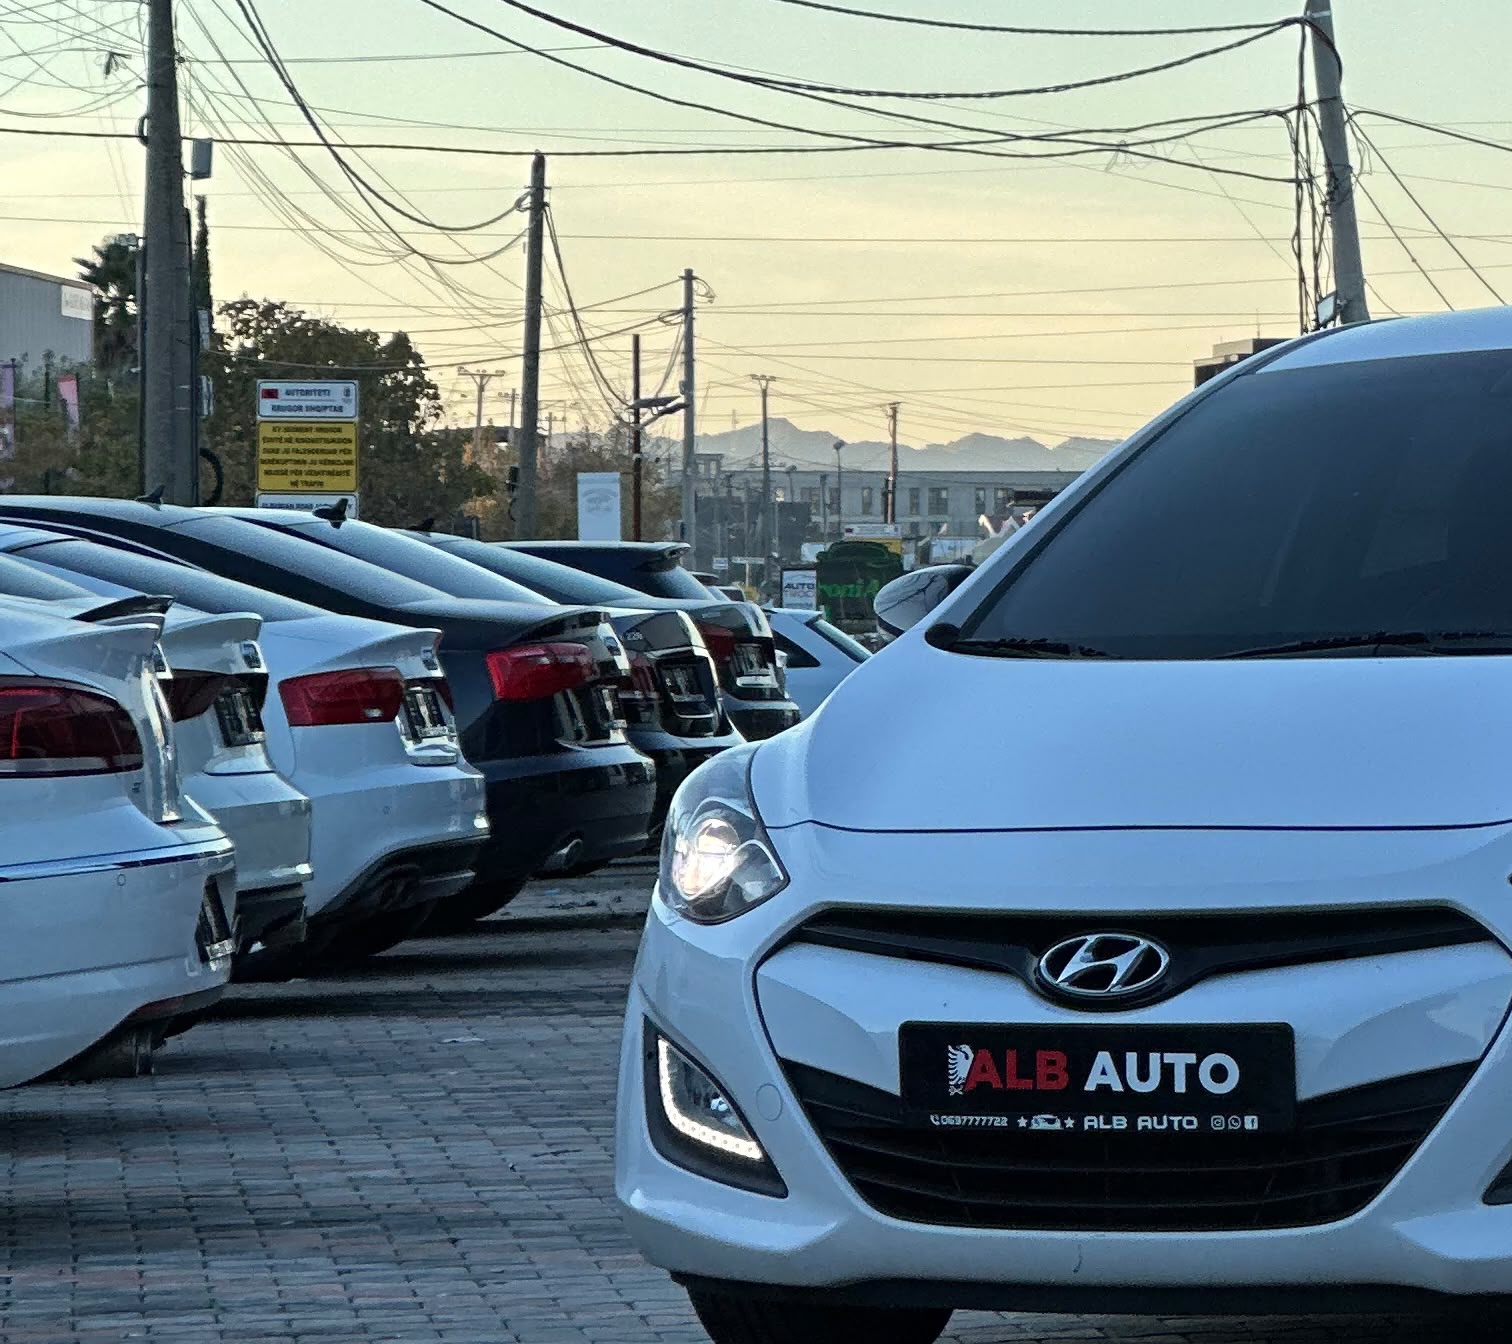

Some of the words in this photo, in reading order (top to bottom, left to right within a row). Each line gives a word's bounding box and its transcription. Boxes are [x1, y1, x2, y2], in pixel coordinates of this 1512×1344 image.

[963, 1048, 1070, 1091] ALB
[1083, 1050, 1241, 1095] AUTO
[1083, 1115, 1128, 1131] ALB
[1137, 1114, 1199, 1131] AUTO
